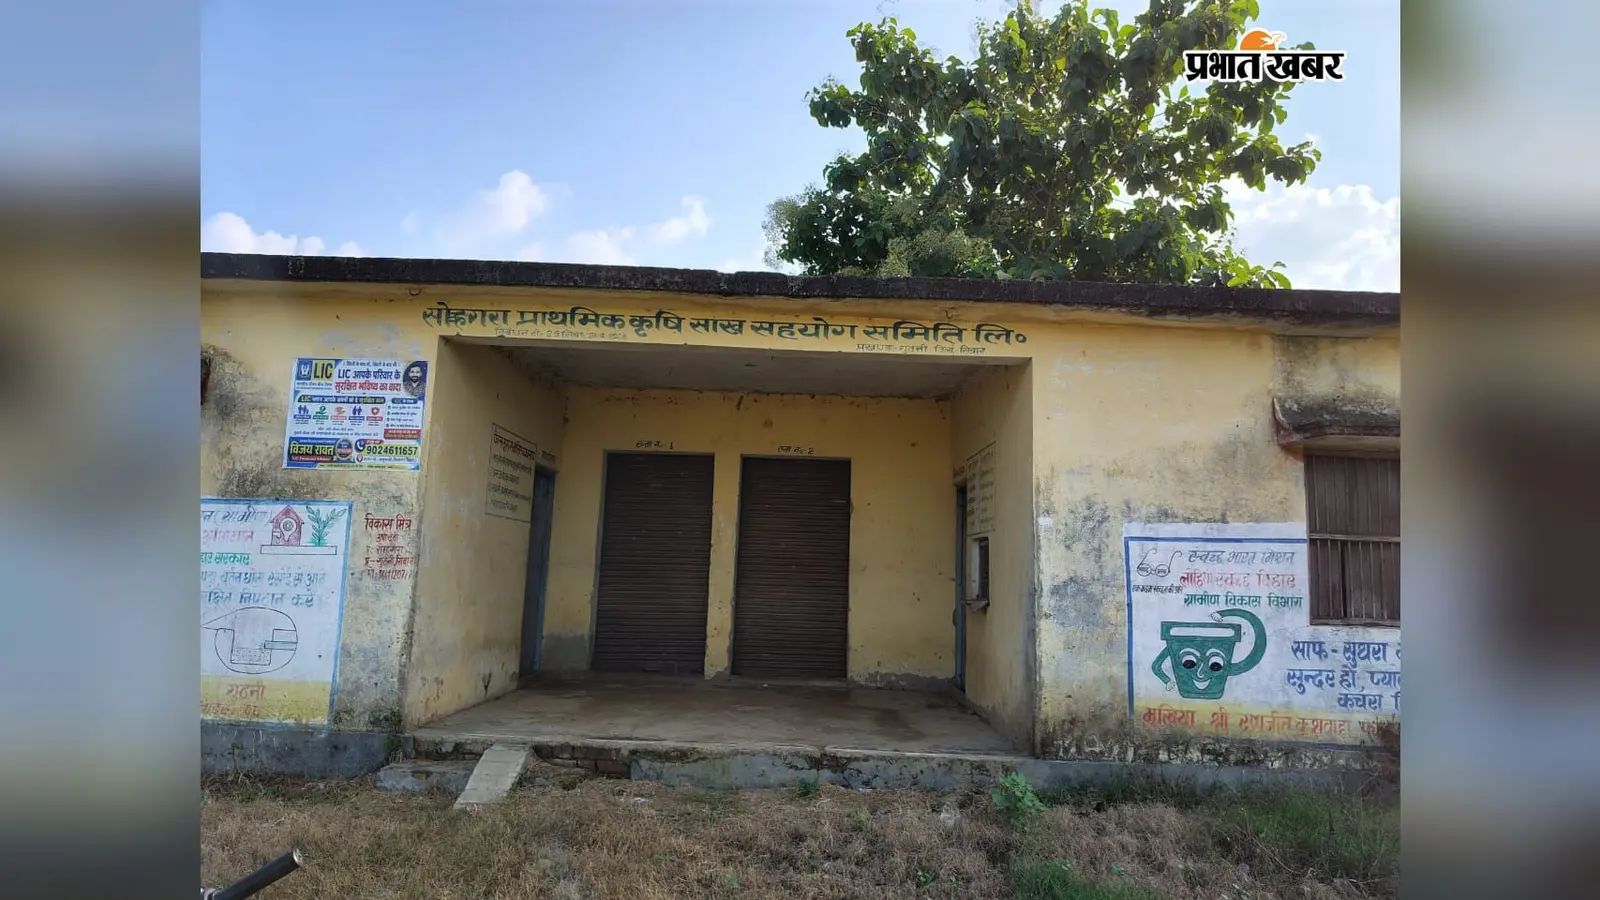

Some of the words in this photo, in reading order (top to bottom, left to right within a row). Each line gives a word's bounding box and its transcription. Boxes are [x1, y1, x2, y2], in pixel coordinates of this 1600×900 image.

[516, 306, 626, 330] प्राथमिक
[629, 309, 686, 338] कृषि
[689, 317, 746, 337] साख
[750, 317, 858, 340] सहयोग
[863, 320, 967, 344] समिति
[313, 360, 333, 379] LIC
[338, 368, 351, 379] LIC
[290, 440, 313, 455] विजय
[314, 442, 334, 456] रावत
[366, 445, 418, 456] 9024611657
[364, 512, 394, 530] विकास
[395, 513, 412, 530] मित्र
[1184, 590, 1220, 608] ग्रामीण
[1225, 591, 1261, 608] विकास
[1268, 592, 1304, 610] विभाग
[1291, 640, 1329, 661] साफ
[1342, 641, 1389, 667] सुथरा
[1286, 669, 1336, 695] सुन्दर
[1338, 692, 1384, 711] कचरा
